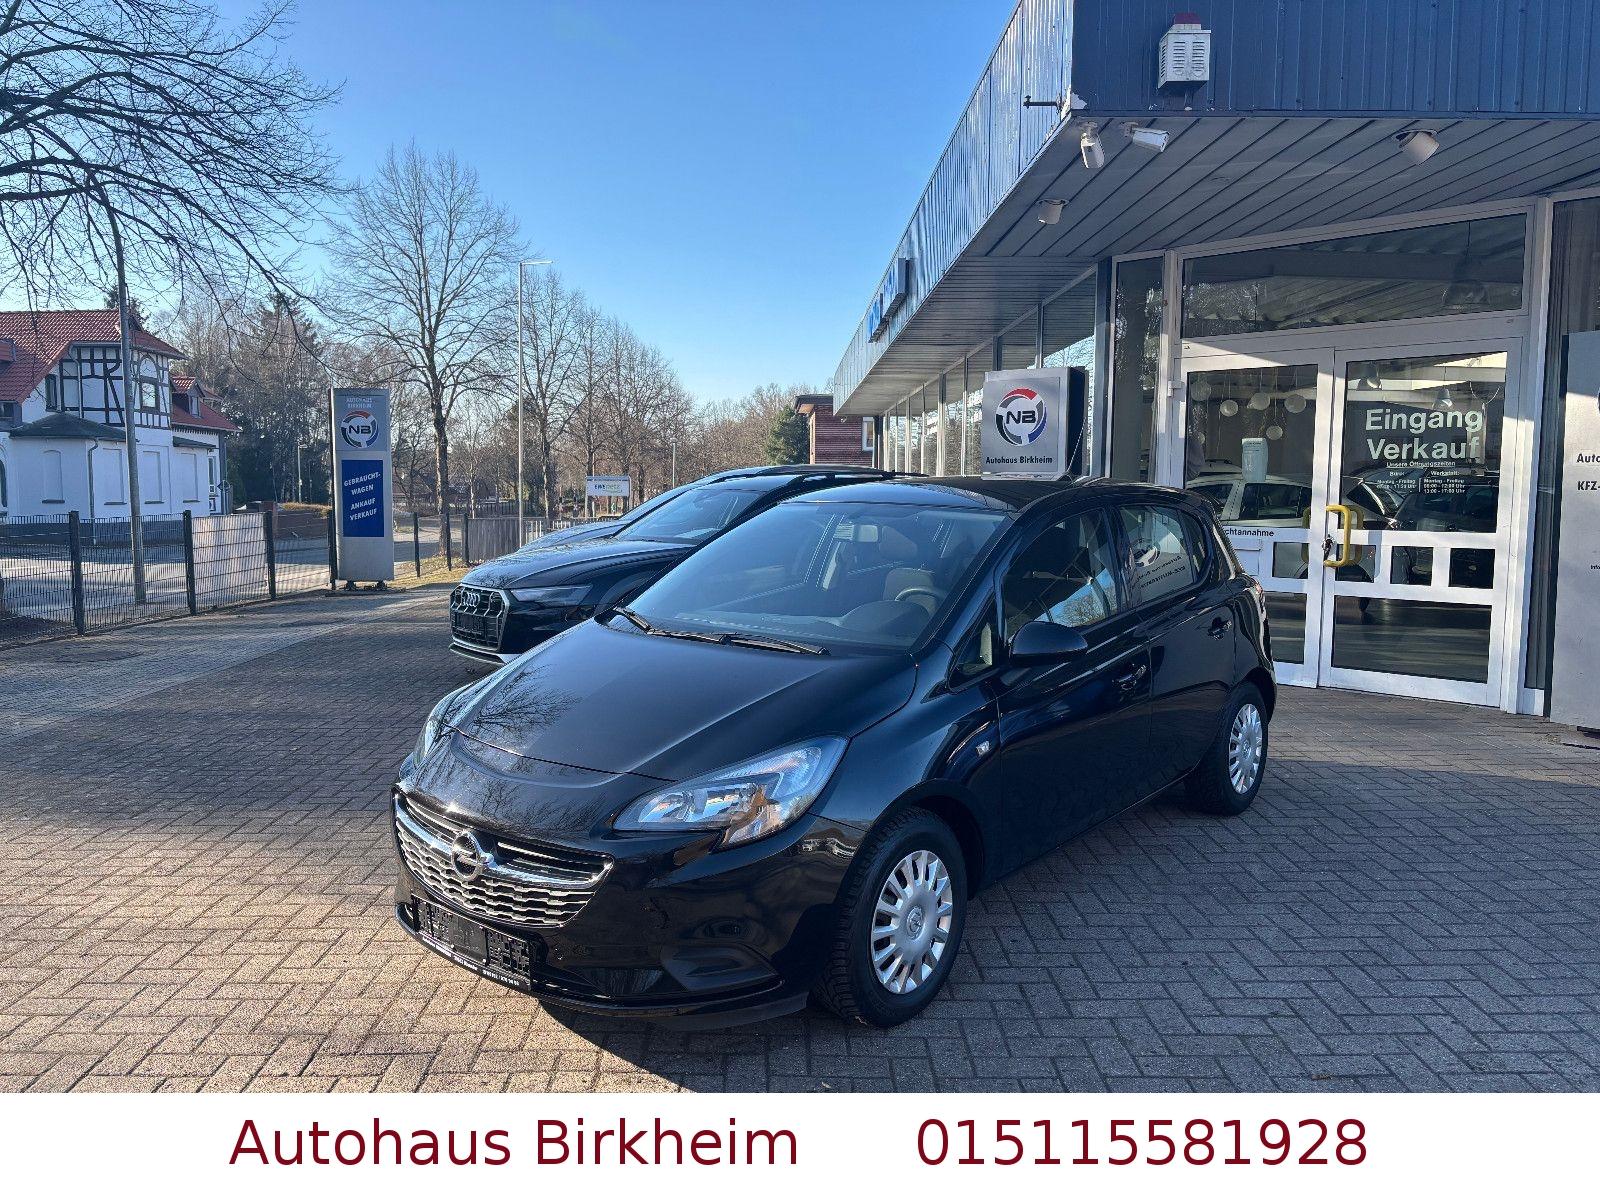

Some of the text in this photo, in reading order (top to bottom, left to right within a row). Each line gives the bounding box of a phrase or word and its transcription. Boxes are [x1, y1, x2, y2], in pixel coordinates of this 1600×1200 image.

[1006, 410, 1037, 424] NB
[1366, 408, 1483, 433] Eingang
[348, 425, 371, 434] NB
[1366, 437, 1480, 460] Verkauf
[986, 455, 1053, 464] Autohaus Birkheim
[343, 472, 381, 487] GEBRAUCHT-
[351, 484, 374, 495] WAGEN
[350, 498, 376, 510] ANKAUF
[350, 508, 378, 520] VERKAUF
